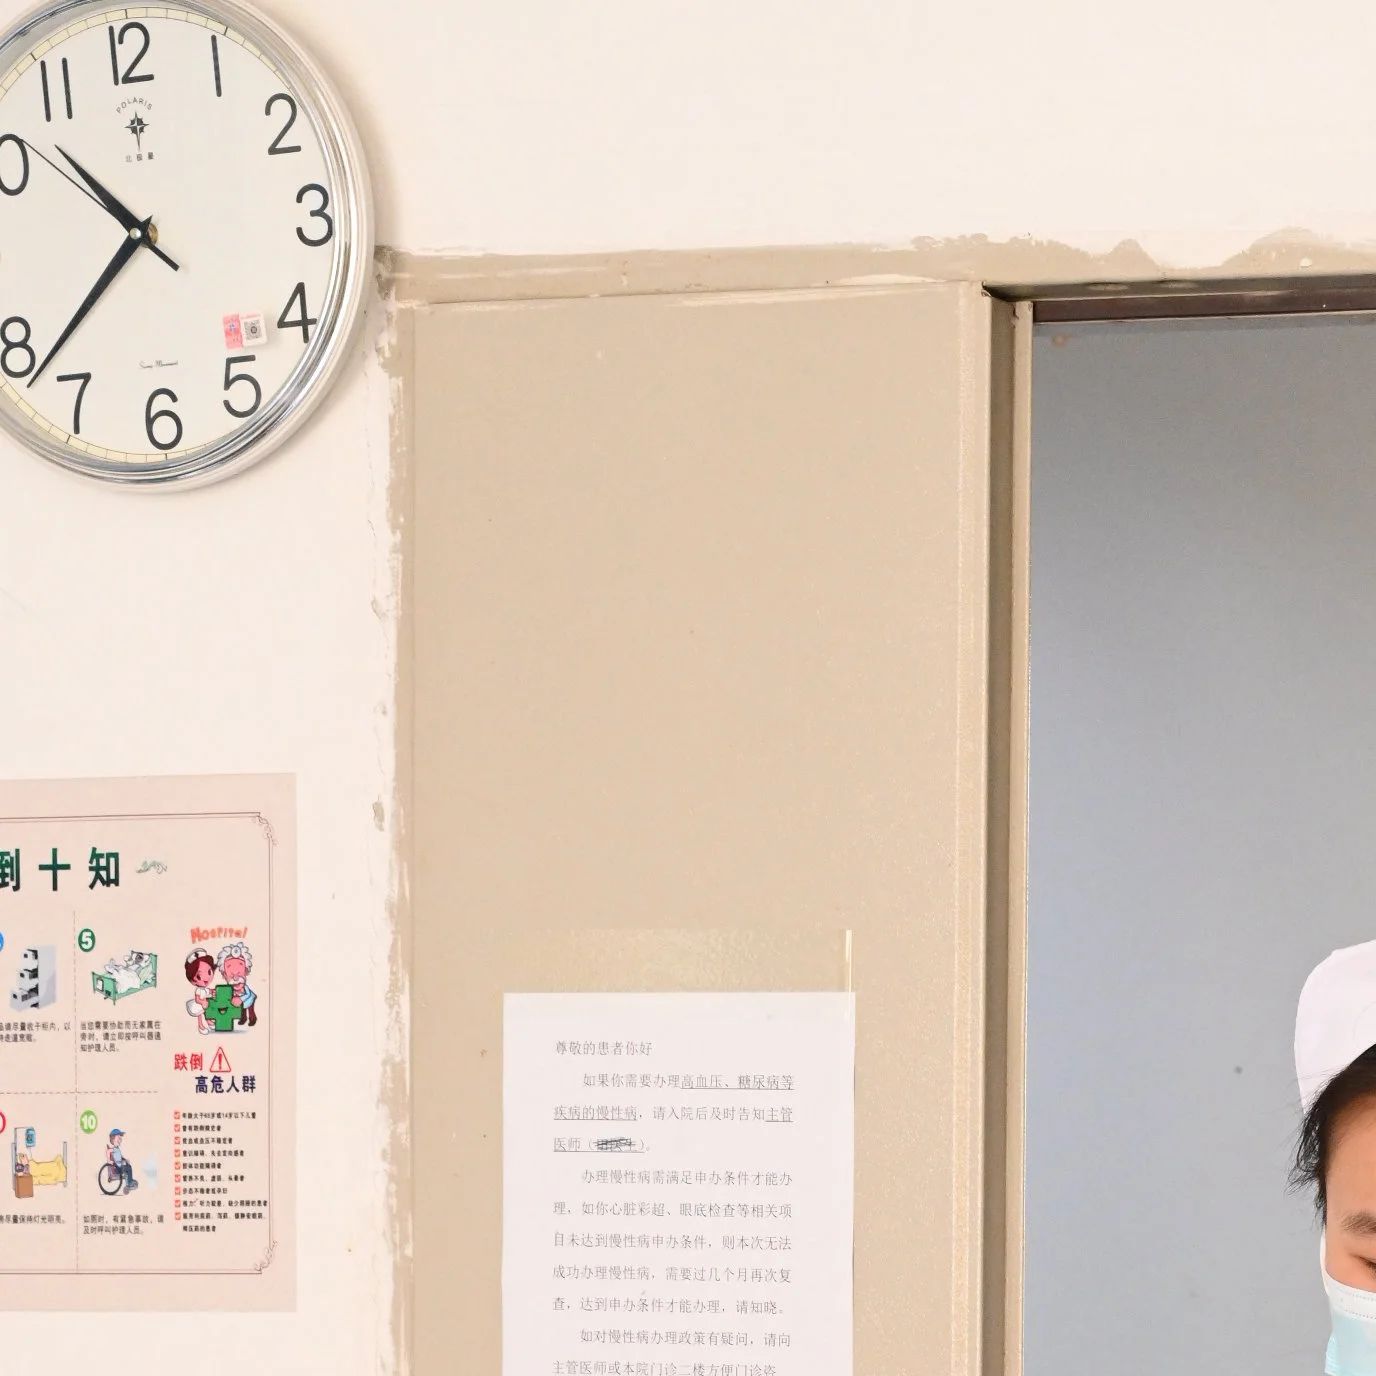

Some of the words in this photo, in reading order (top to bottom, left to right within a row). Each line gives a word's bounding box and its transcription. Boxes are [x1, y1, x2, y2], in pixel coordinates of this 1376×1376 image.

[109, 22, 154, 85] 12
[211, 35, 222, 97] 1
[40, 58, 73, 122] 11
[116, 97, 152, 113] POLARIS
[265, 93, 301, 155] 2
[0, 134, 29, 196] 0
[296, 184, 333, 246] 3
[277, 282, 317, 343] 4
[0, 316, 36, 378] 8
[57, 372, 91, 434] 7
[223, 355, 262, 418] 5
[146, 388, 183, 450] 6
[174, 1053, 203, 1071] 跌倒
[556, 1040, 652, 1056] 尊敬的患者你好
[194, 1075, 256, 1094] 高危人群
[584, 1073, 795, 1090] 如果你需要办理高血压、糖尿病等
[582, 1168, 792, 1186] 办理慢性病需满足申办条件才能办
[553, 1201, 792, 1221] 理，如你心脏彩超、眼底检查等相关项
[553, 1264, 791, 1287] 成功办理慢性病，需要过几个月再次复
[580, 1329, 790, 1347] 如对慢性病办理政策有疑问，请向
